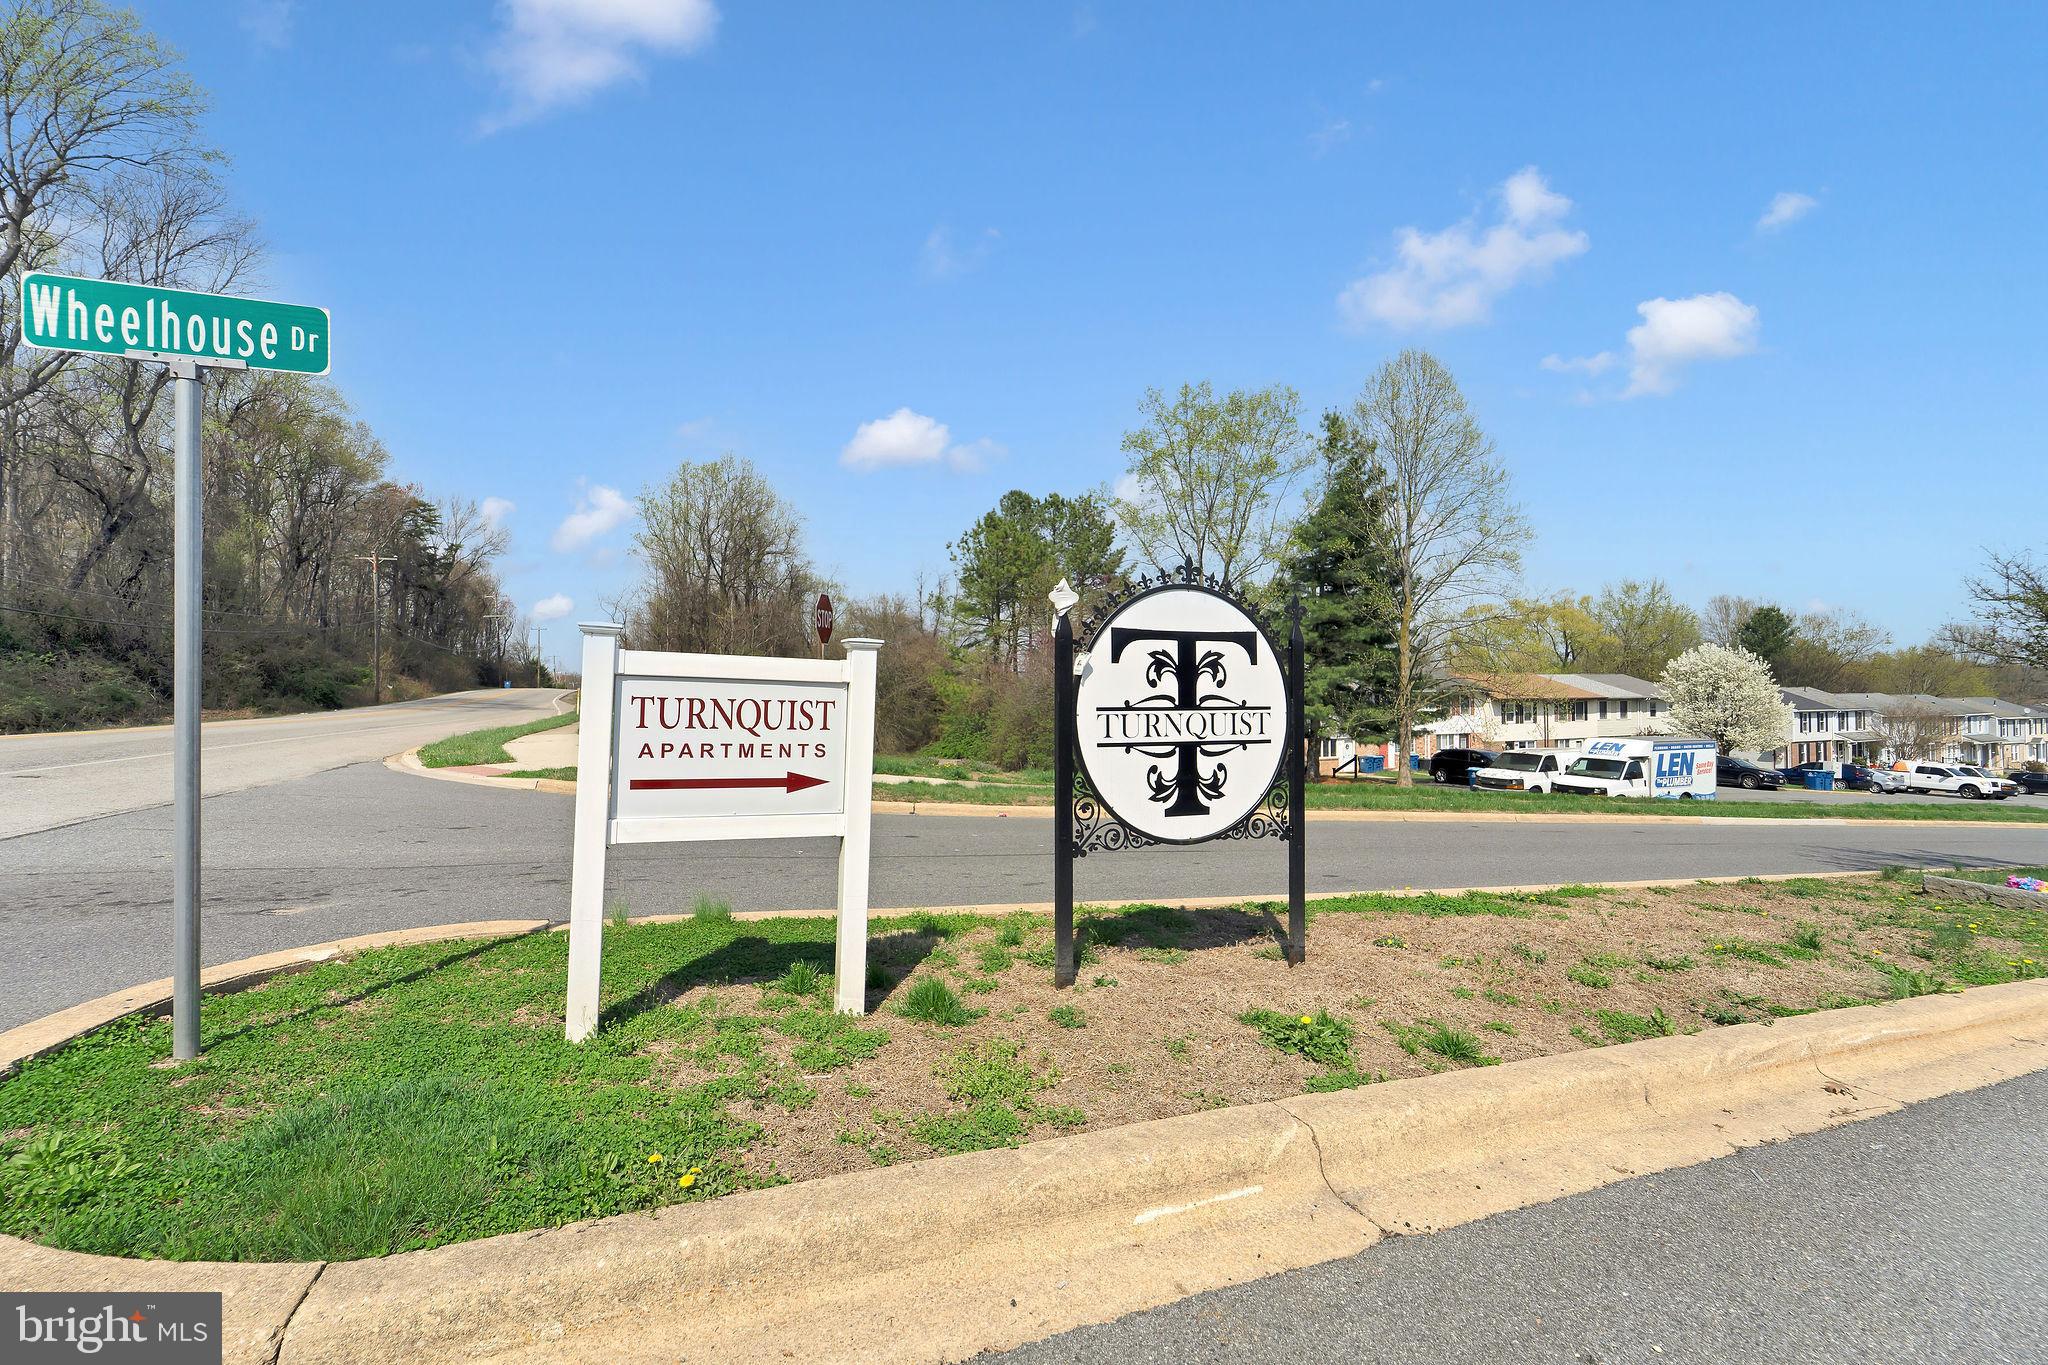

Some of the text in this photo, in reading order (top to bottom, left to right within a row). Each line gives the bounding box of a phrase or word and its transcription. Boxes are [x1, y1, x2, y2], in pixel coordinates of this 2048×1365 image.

[29, 283, 319, 359] Wheelhouse Dr
[817, 609, 832, 628] STOP
[631, 695, 836, 737] TURNQUIST
[1097, 712, 1272, 739] TURNQUIST
[638, 743, 826, 758] APARTMENTS
[1590, 741, 1626, 752] LEN
[1656, 752, 1695, 777] LEN
[1662, 776, 1693, 787] PLUMBER
